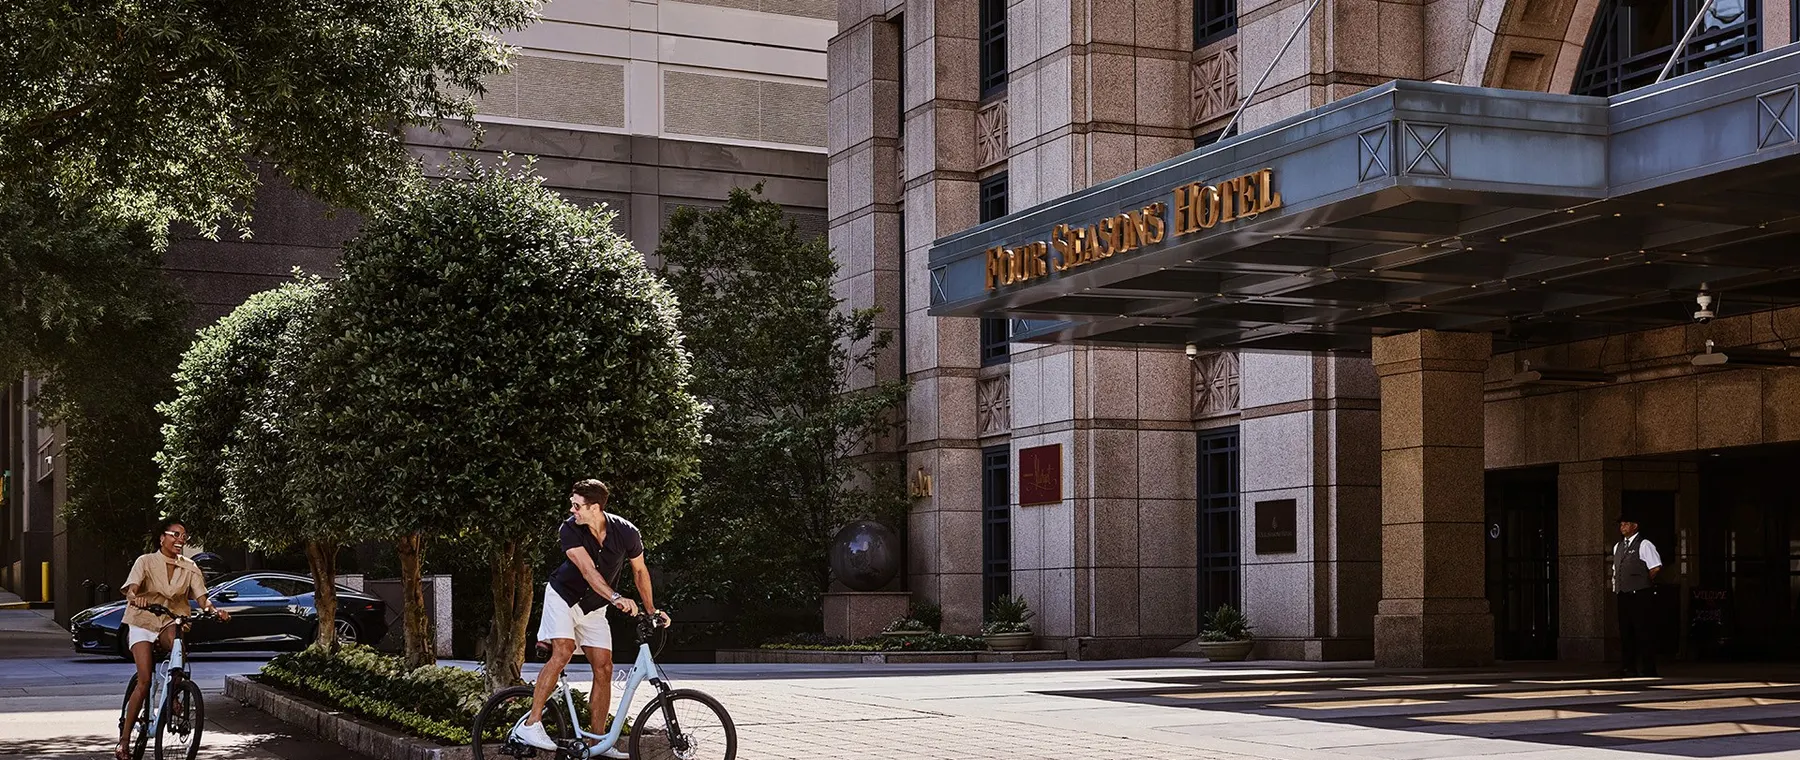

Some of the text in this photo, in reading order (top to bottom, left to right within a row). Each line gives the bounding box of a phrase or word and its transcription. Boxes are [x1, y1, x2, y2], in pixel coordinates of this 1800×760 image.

[984, 167, 1282, 291] FOUR SEASONS HOTEL
